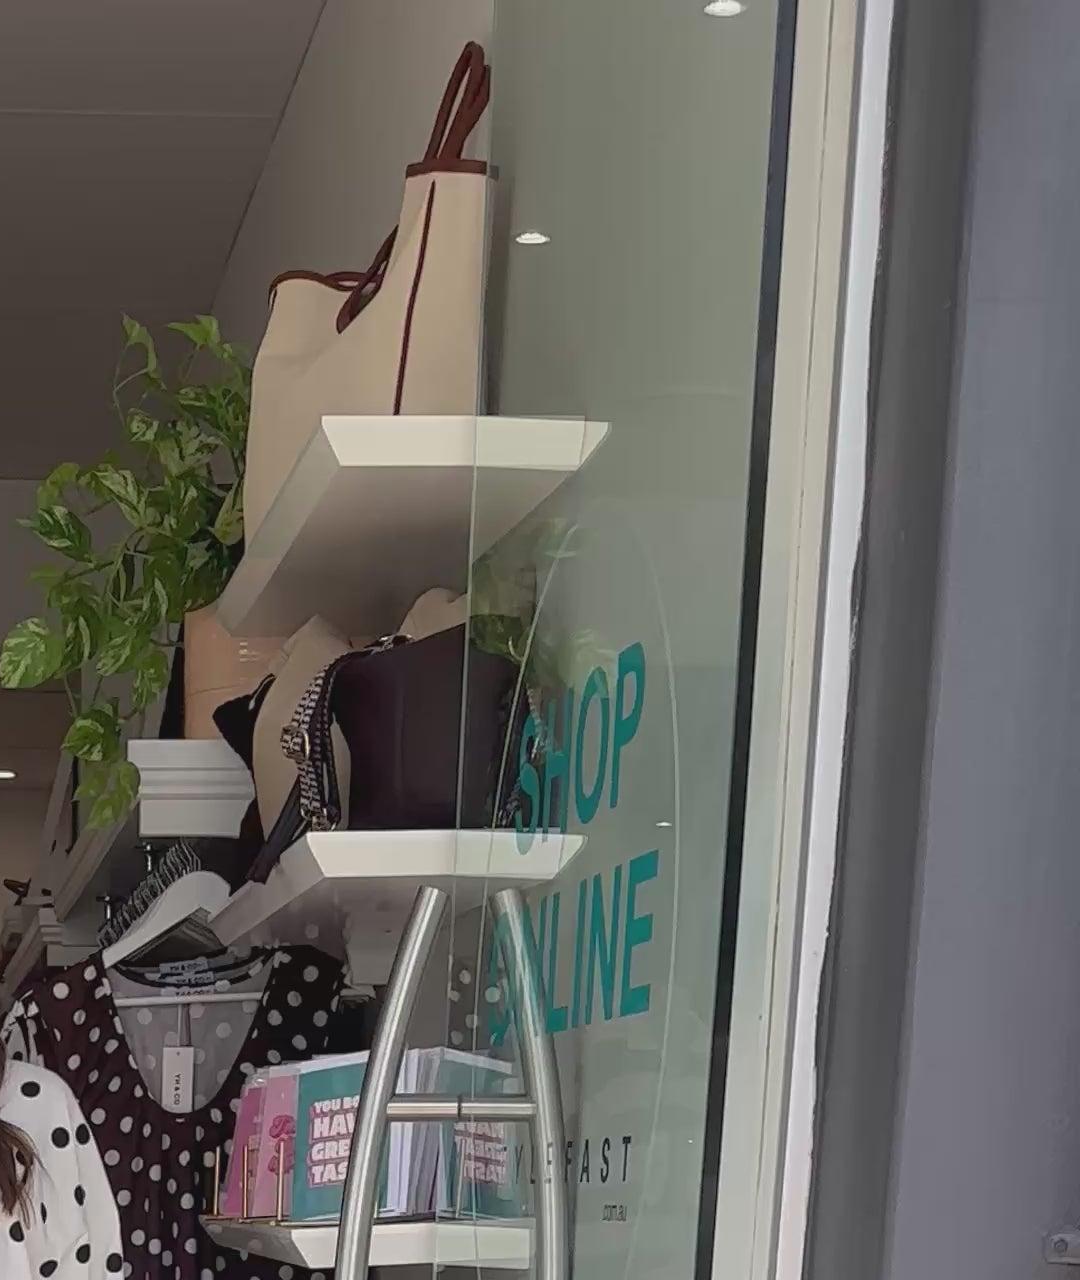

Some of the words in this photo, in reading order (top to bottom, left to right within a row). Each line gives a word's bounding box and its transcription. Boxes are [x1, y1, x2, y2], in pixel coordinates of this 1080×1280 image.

[514, 641, 646, 856] SHOP
[312, 1112, 356, 1140] HAV
[311, 1138, 352, 1161] GRE
[311, 1161, 349, 1184] TAS
